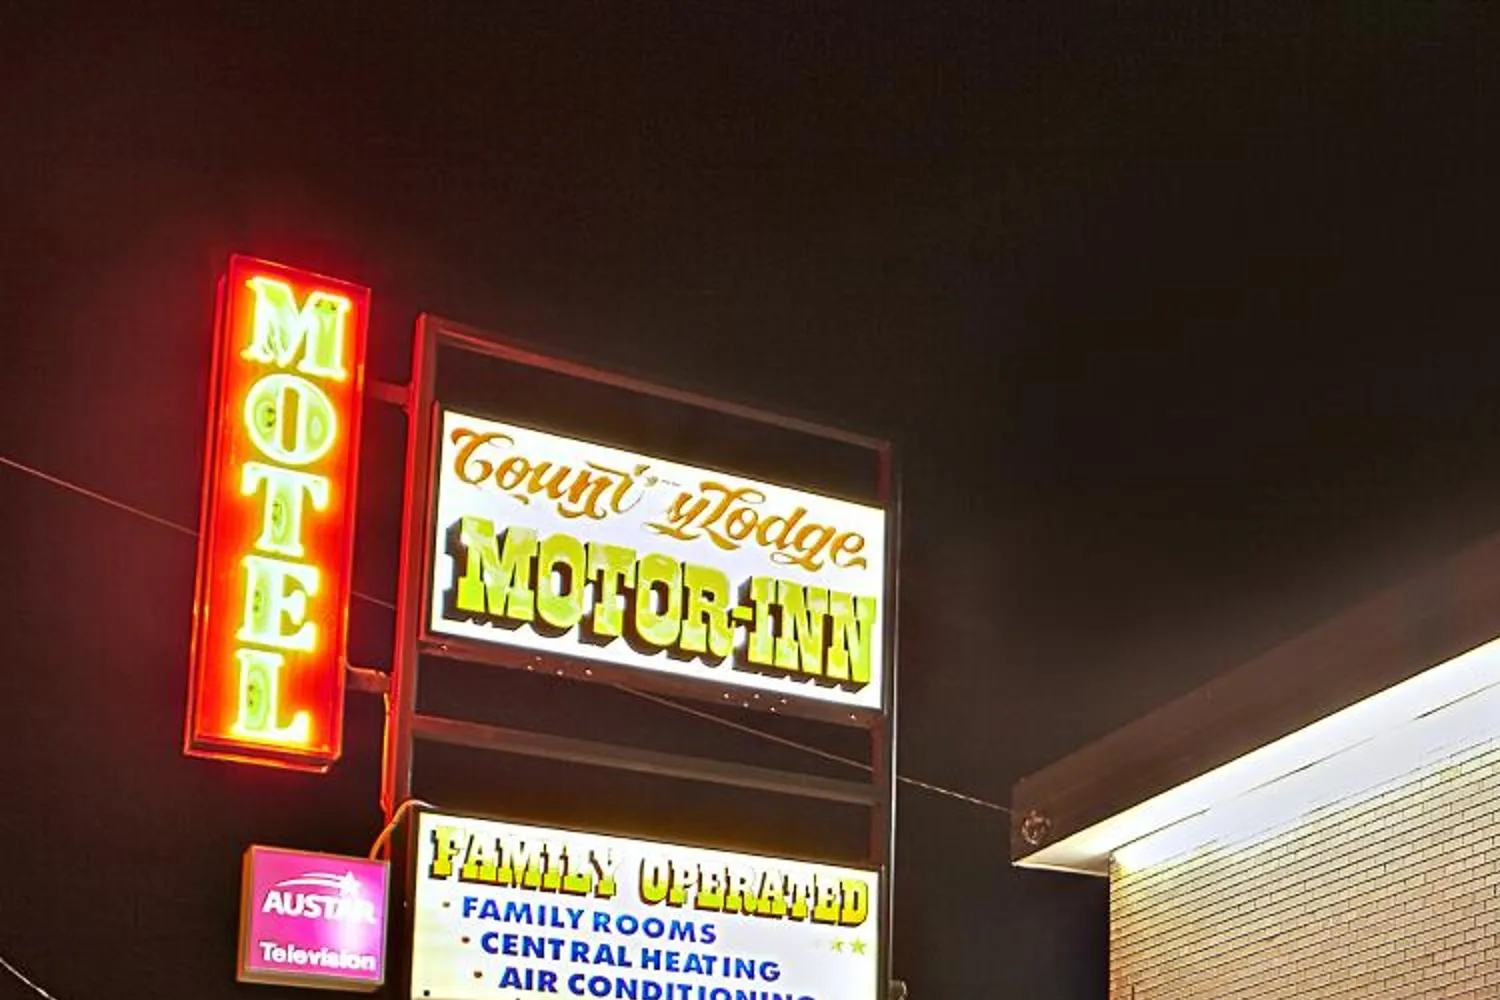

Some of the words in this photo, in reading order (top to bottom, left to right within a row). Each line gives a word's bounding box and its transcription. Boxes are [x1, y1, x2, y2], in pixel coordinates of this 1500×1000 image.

[231, 276, 350, 745] MOTEL
[450, 427, 710, 540] County
[699, 480, 867, 572] Lodge
[445, 515, 876, 692] MOTOR-INN
[429, 824, 623, 899] FAMILY
[638, 847, 869, 927] OPERATED
[259, 941, 377, 970] Television
[462, 896, 585, 930] FAMILY
[593, 911, 717, 944] ROOMS
[481, 932, 632, 969] CENTRAL
[641, 950, 781, 983] HEATING
[498, 967, 558, 994] AIR
